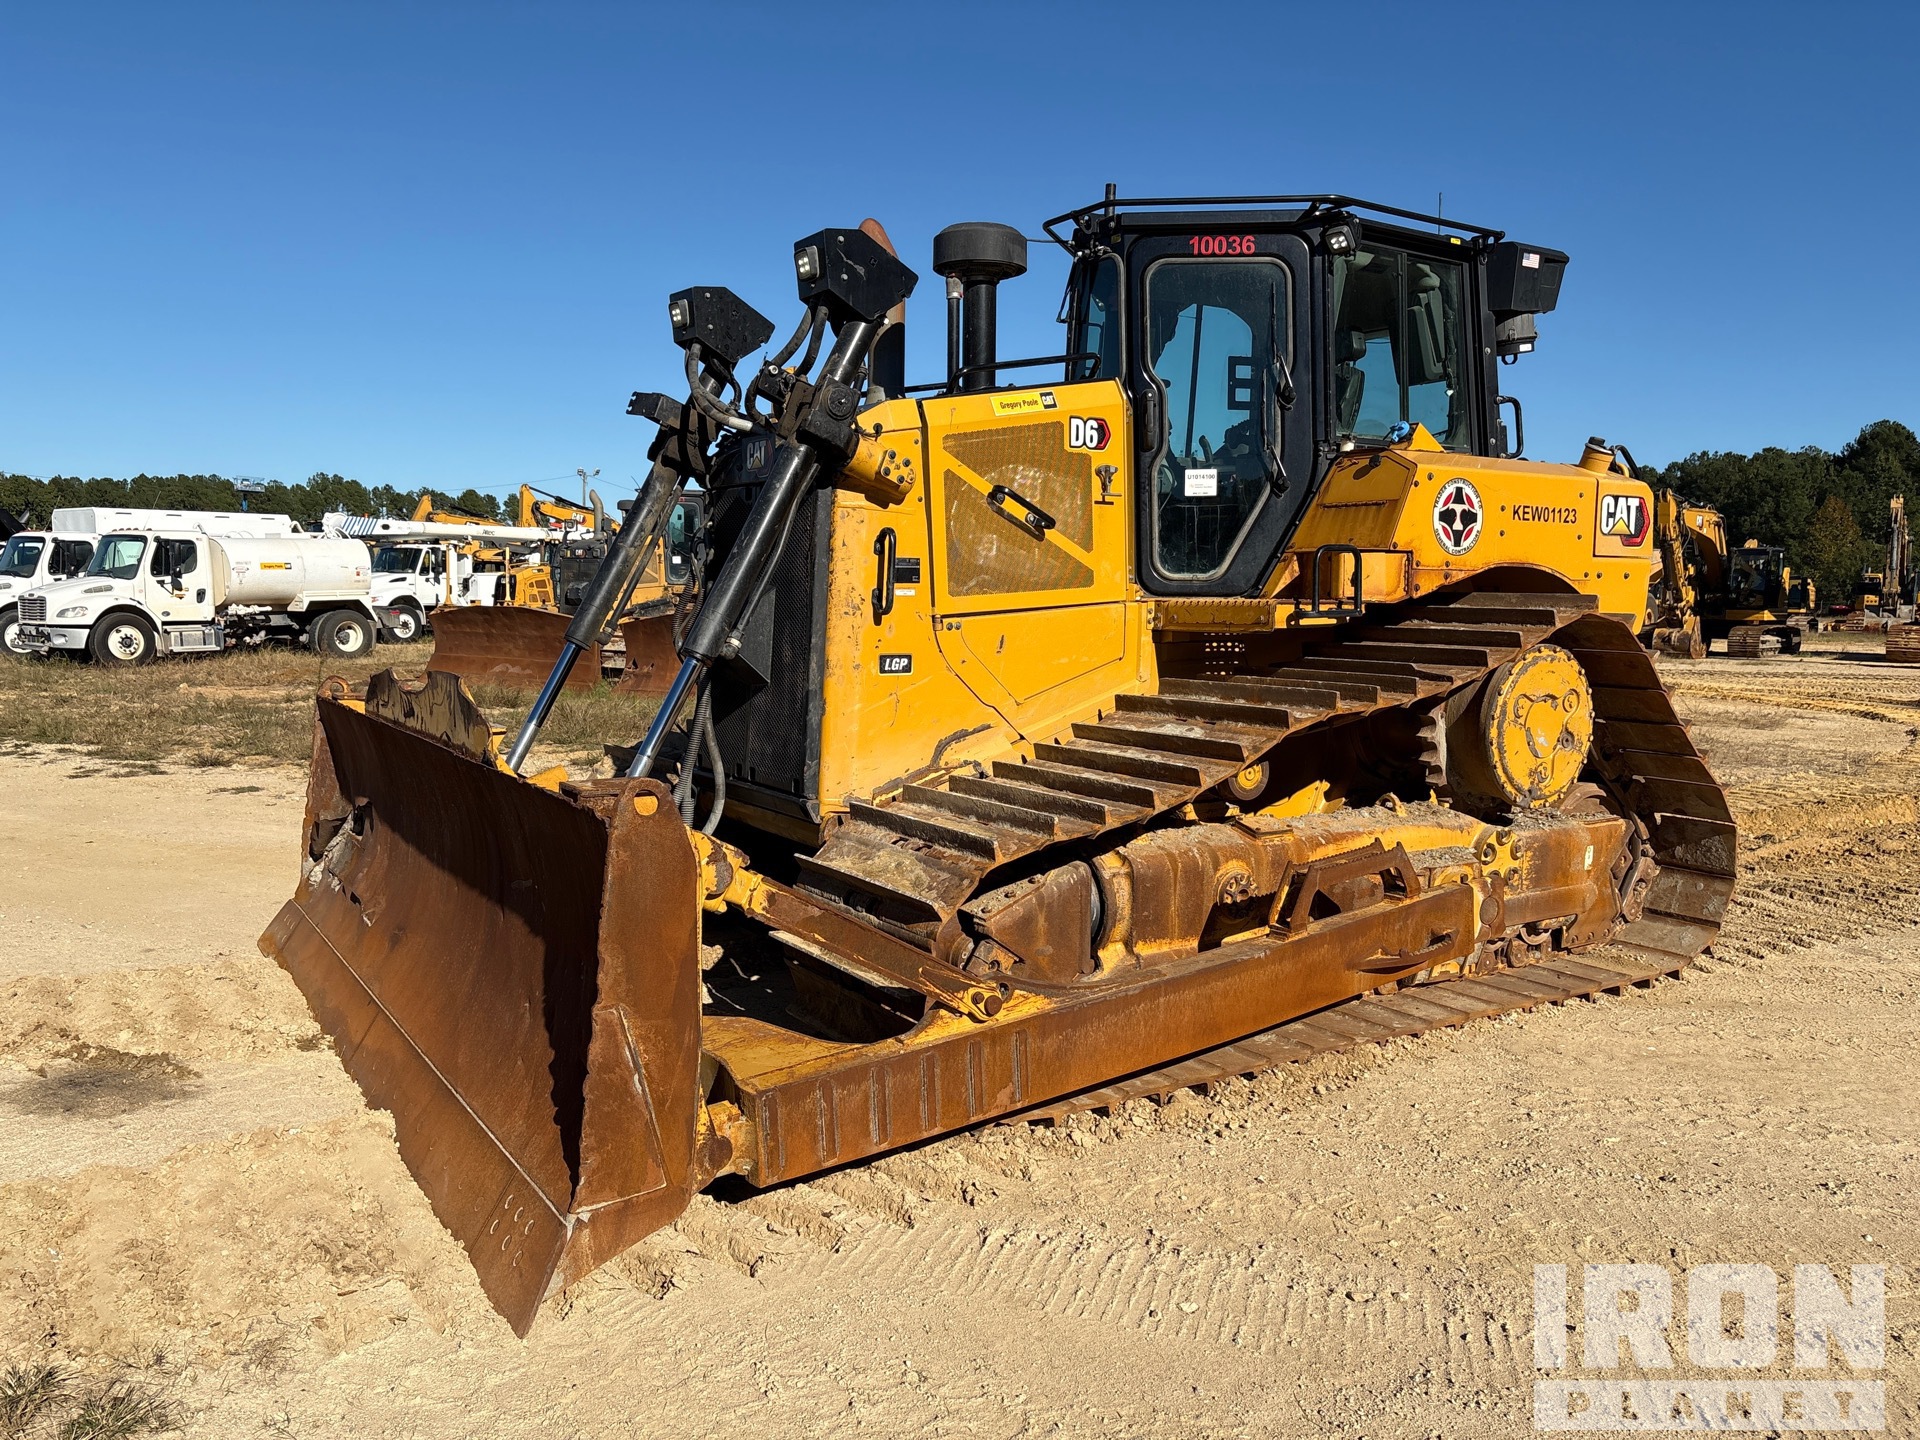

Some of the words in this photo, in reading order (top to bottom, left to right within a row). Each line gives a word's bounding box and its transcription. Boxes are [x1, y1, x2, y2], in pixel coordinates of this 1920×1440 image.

[1189, 235, 1256, 255] 10036
[1000, 401, 1021, 409] Gregory
[1022, 399, 1039, 407] Poole
[1041, 395, 1054, 405] CAT
[1070, 418, 1099, 448] D6
[747, 440, 766, 470] CAT
[572, 512, 585, 523] CAT
[1512, 505, 1577, 524] KEW01123
[1601, 495, 1640, 535] CAT
[1451, 529, 1480, 554] CONTRACTORS
[884, 658, 908, 671] LGP
